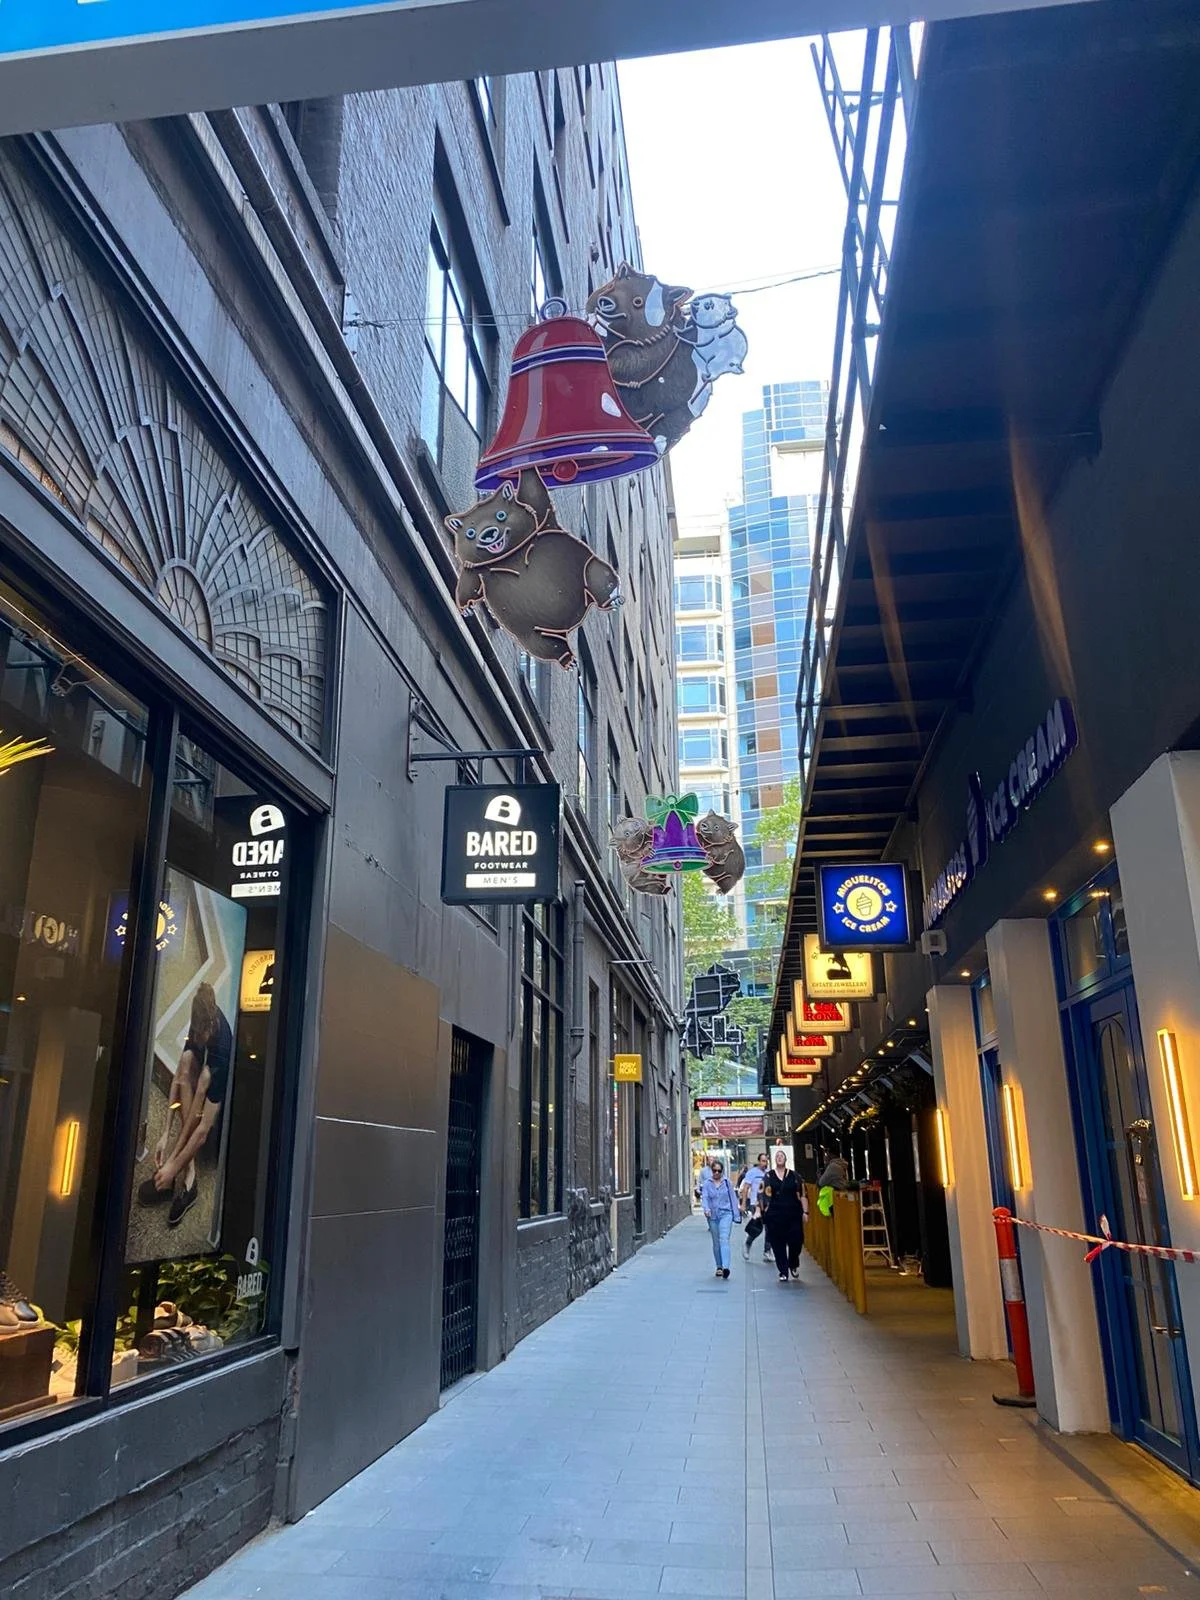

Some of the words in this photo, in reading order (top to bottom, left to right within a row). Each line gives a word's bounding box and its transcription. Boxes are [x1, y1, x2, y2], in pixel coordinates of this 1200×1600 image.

[466, 831, 537, 856] BARED
[474, 862, 528, 870] FOOTWEAR
[483, 876, 519, 884] MEN'S
[837, 875, 892, 898] MIGUELITOS
[841, 917, 858, 930] ICE
[859, 916, 890, 932] CREAM
[237, 1271, 262, 1300] BARED
